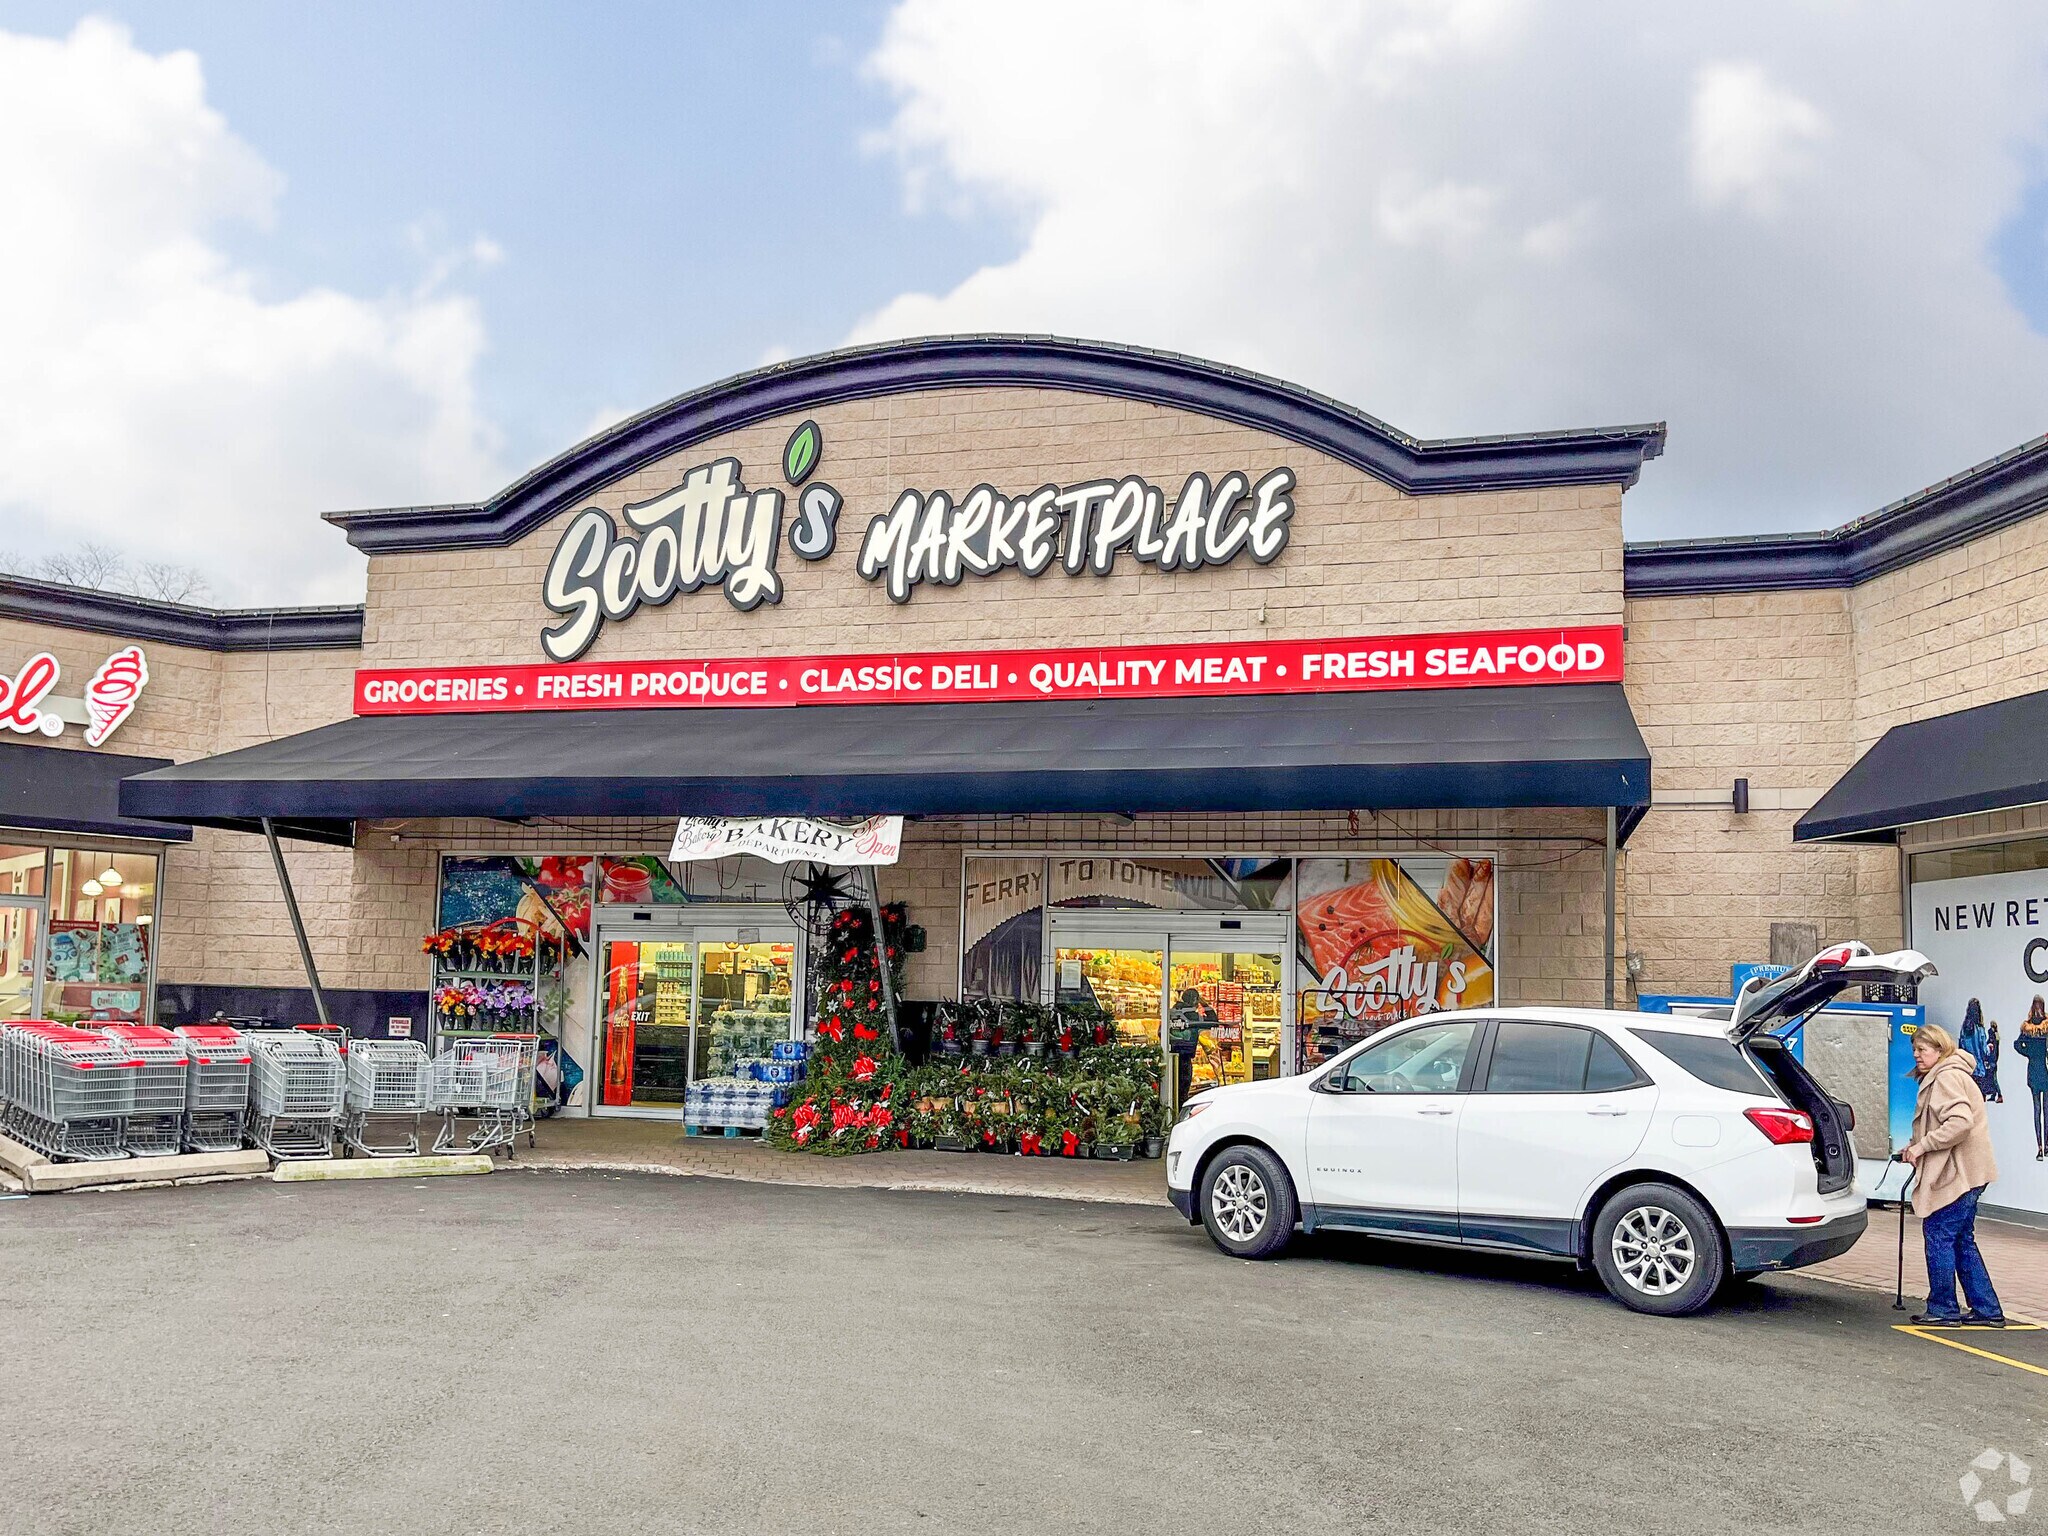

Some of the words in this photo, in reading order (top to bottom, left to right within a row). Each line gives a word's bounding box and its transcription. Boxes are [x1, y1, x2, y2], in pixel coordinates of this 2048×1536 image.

[544, 424, 842, 661] Scotty's
[861, 471, 1291, 599] MARKETPLACE
[364, 678, 508, 703] GROCERIES
[537, 673, 622, 699] FRESH
[631, 671, 768, 698] PRODUCE
[800, 666, 923, 694] CLASSIC
[931, 664, 998, 690] DELI
[1029, 659, 1167, 693] QUALITY
[1175, 657, 1268, 685] MEAT
[1303, 651, 1415, 681] FRESH
[1426, 644, 1605, 676] SEAFOOD
[724, 818, 853, 852] BAKERY
[855, 831, 897, 859] Open
[967, 872, 1043, 905] FERRY
[1059, 860, 1093, 884] TO
[1935, 902, 1995, 931] NEW
[1316, 945, 1467, 1020] Scotty's
[1753, 964, 1789, 974] PREMIU
[631, 1011, 650, 1022] EXIT
